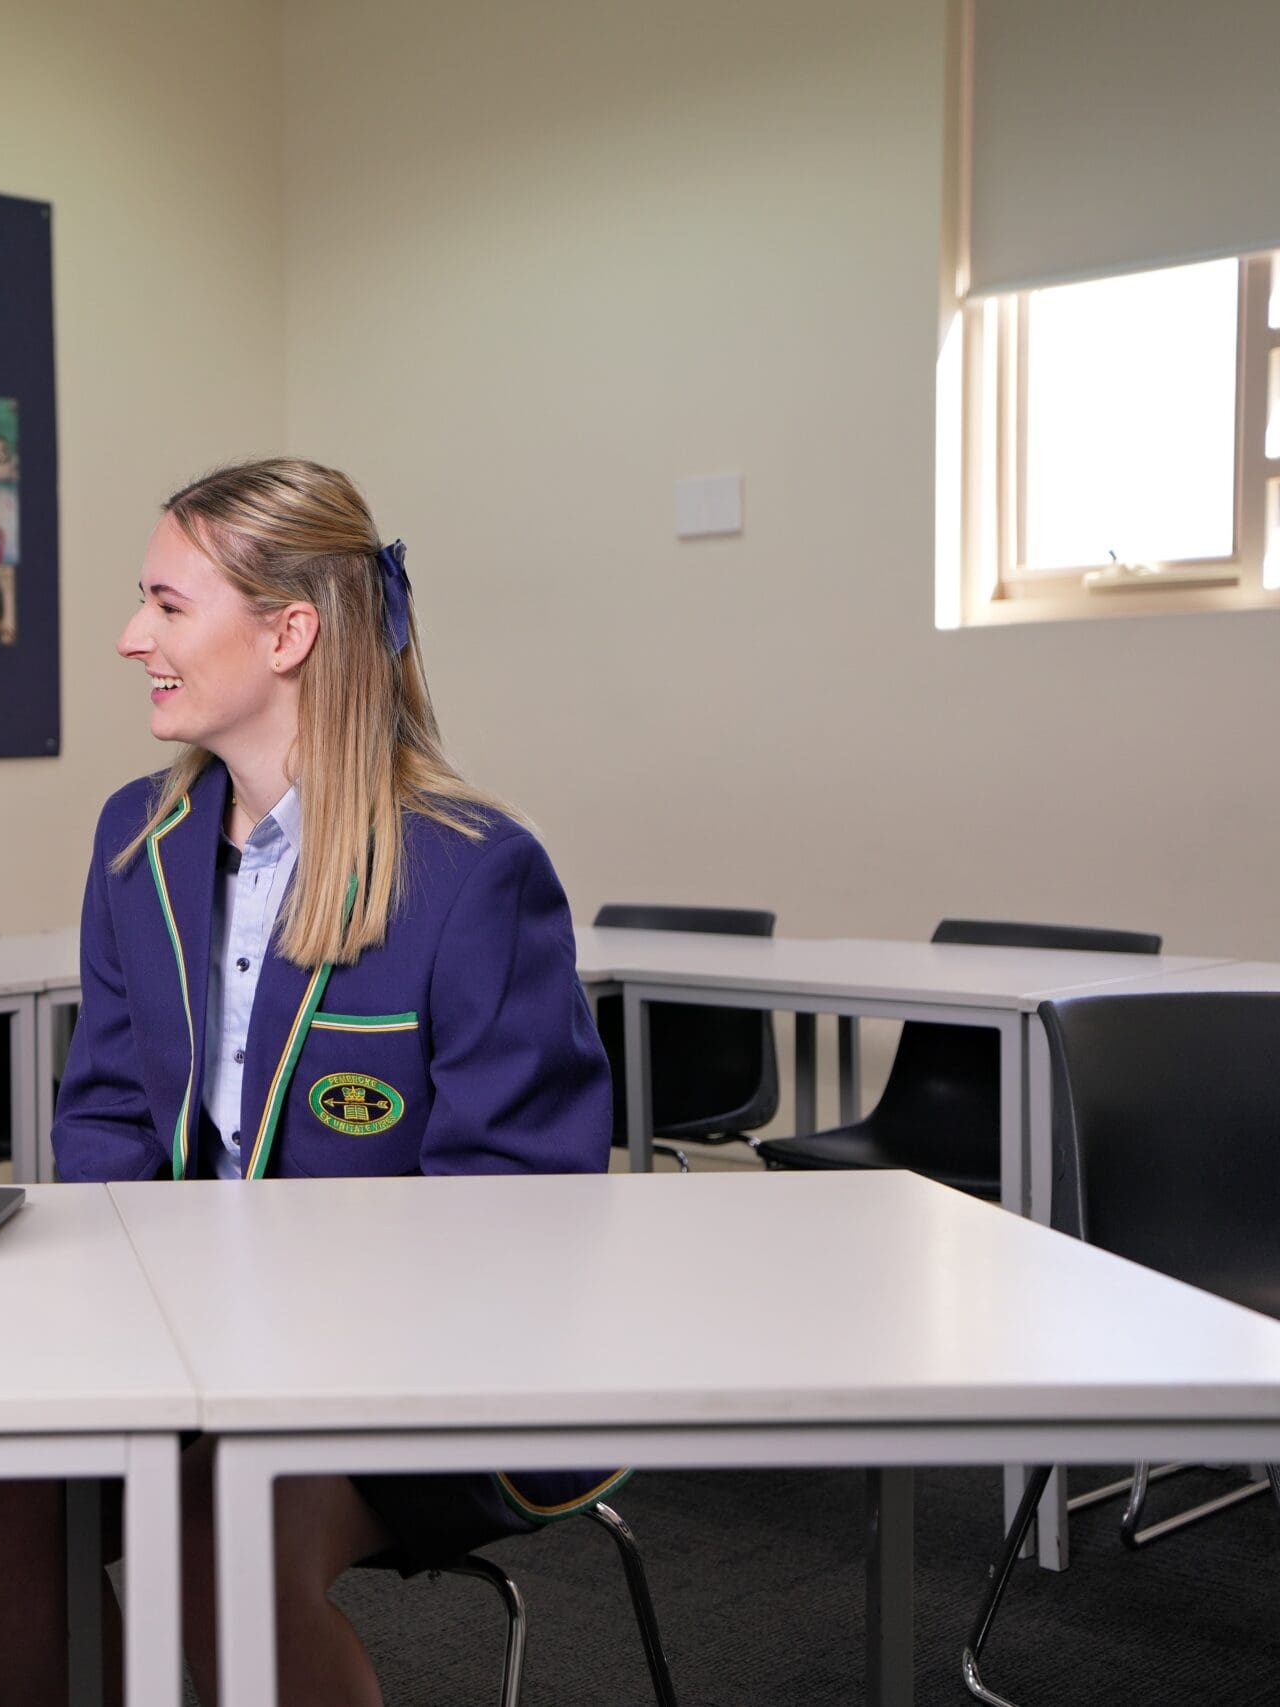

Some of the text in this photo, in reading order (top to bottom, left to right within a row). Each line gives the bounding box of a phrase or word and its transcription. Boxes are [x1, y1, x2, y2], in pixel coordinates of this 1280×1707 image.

[328, 1075, 377, 1087] PEMBROKE
[320, 1111, 330, 1123] EX
[333, 1121, 371, 1133] UNITATE
